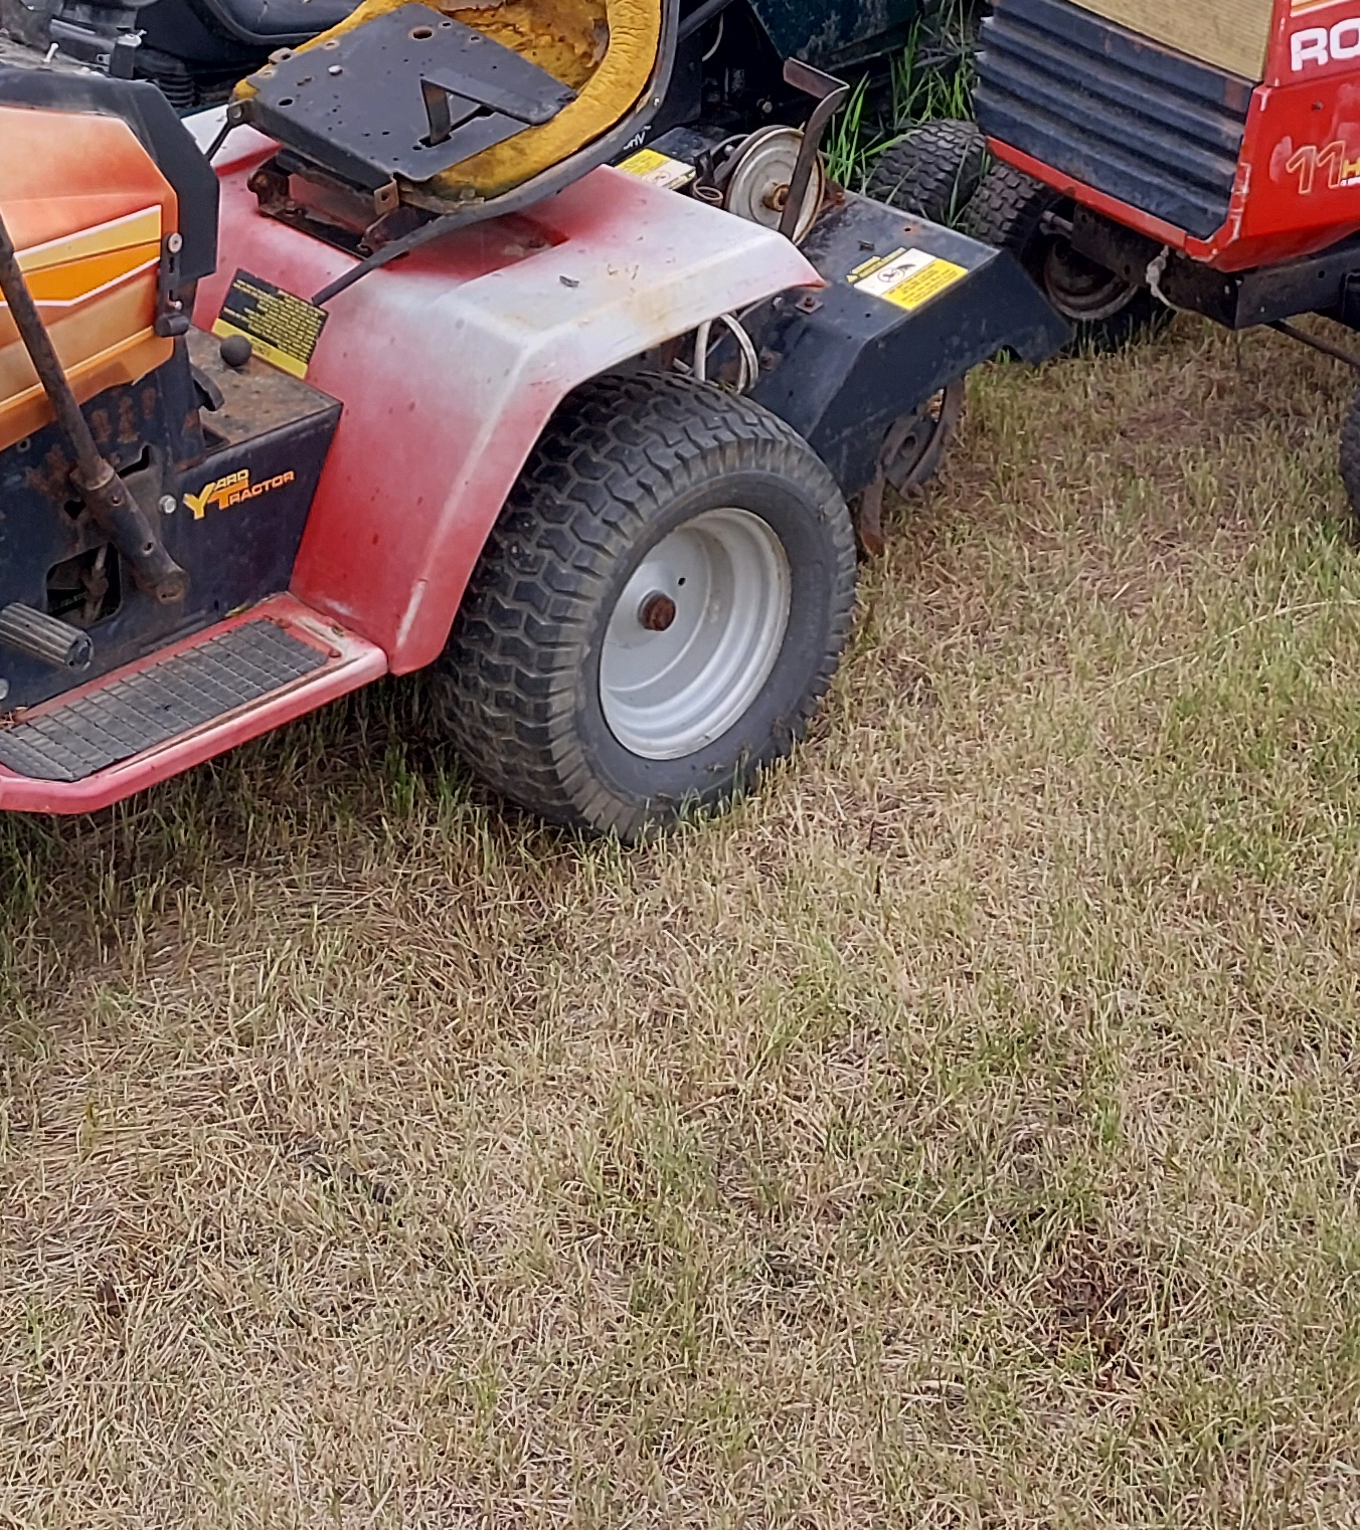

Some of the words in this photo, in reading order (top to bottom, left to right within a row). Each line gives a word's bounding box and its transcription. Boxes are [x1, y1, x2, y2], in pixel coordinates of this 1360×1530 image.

[1286, 141, 1346, 194] 11
[183, 469, 250, 520] YARD
[207, 471, 295, 510] TRACTOR
